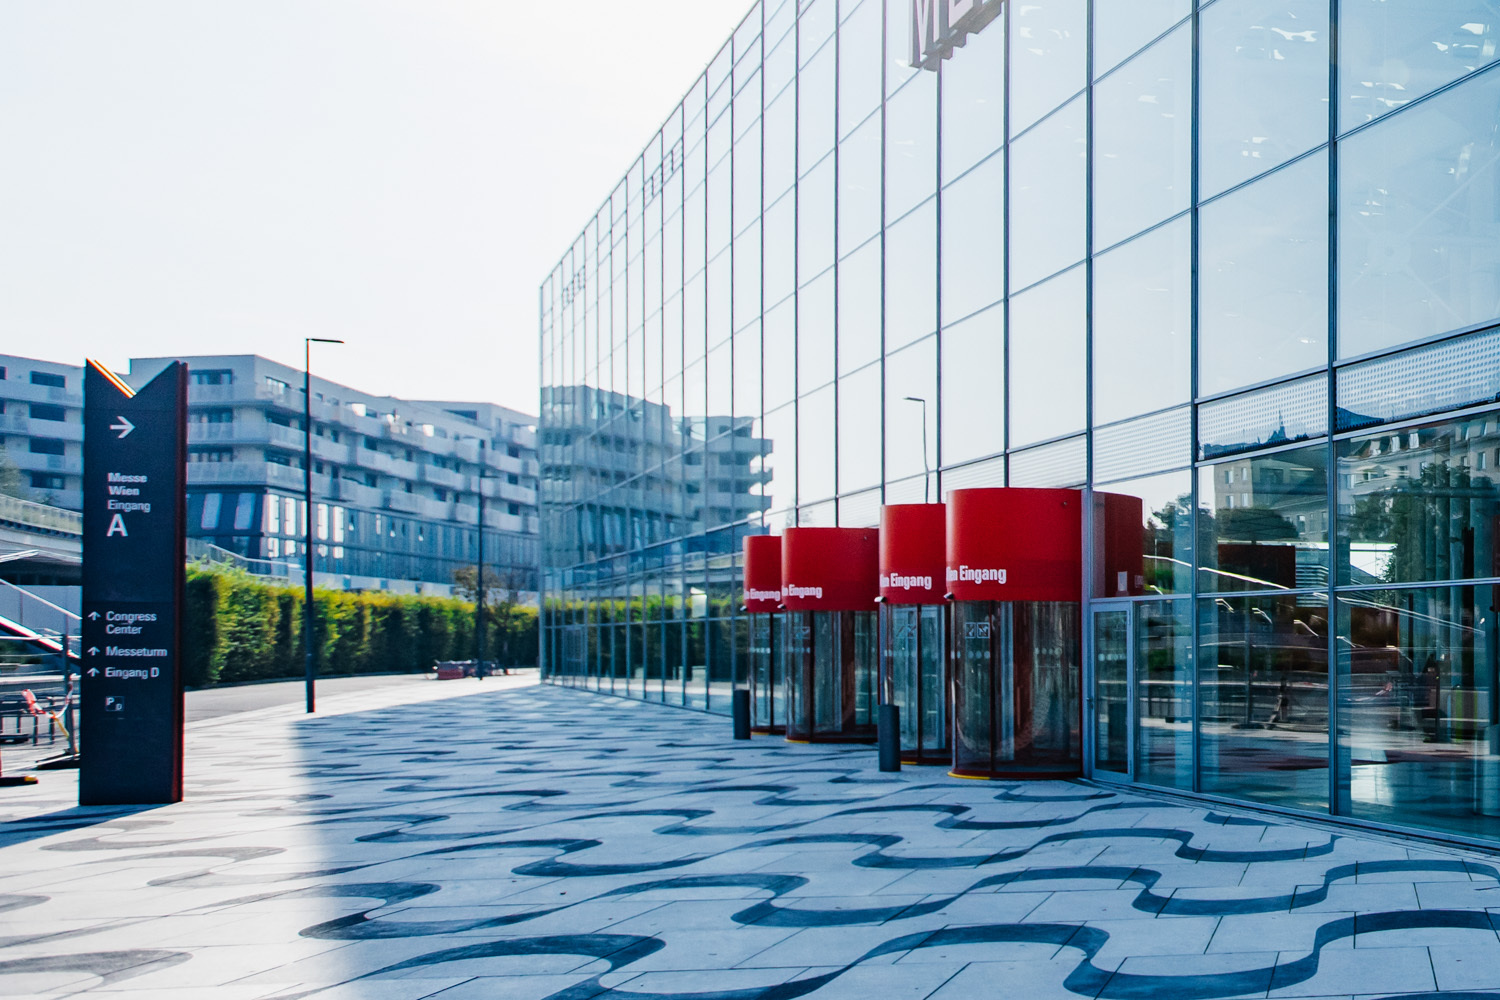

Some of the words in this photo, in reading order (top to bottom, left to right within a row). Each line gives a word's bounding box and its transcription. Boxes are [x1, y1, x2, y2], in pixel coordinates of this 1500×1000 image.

[107, 472, 148, 483] Messe
[108, 485, 140, 496] Wien
[107, 499, 151, 513] Eingang
[106, 513, 128, 537] A
[890, 572, 932, 590] Eingang
[959, 565, 1007, 584] Eingang
[788, 584, 823, 599] Eingang
[105, 610, 157, 624] Congress
[105, 624, 143, 635] Center
[105, 646, 168, 657] Messeturm
[105, 667, 148, 680] Eingang
[150, 667, 160, 678] D
[106, 697, 115, 706] P
